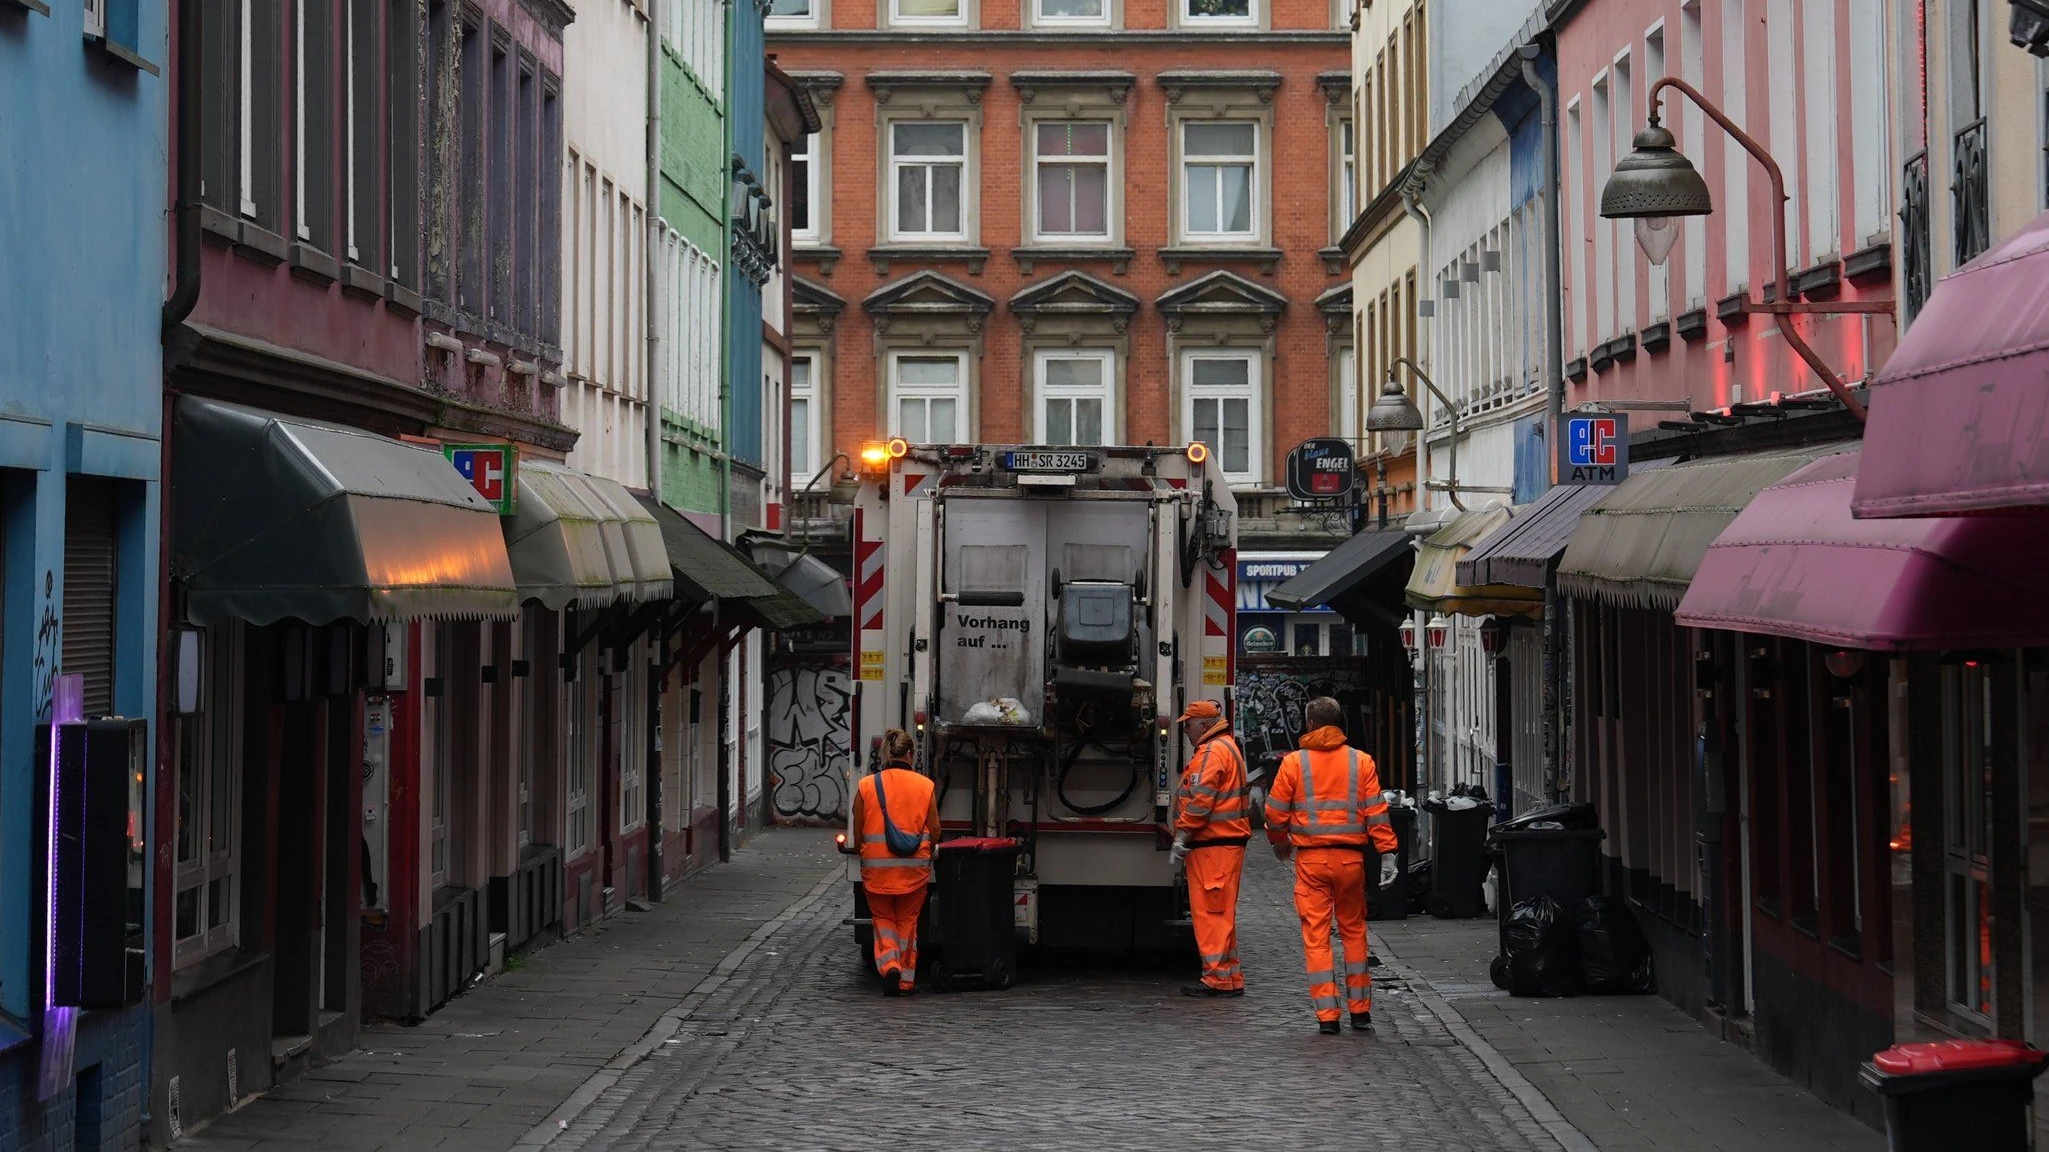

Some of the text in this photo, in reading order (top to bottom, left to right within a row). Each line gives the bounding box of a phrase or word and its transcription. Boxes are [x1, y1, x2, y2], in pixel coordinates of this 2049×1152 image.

[1014, 454, 1085, 468] HH SR 3245
[1315, 457, 1349, 469] ENGEL
[1571, 466, 1615, 481] ATM
[1246, 564, 1297, 577] SPORTPUB
[957, 614, 1030, 633] Vorhang
[957, 635, 985, 648] auf
